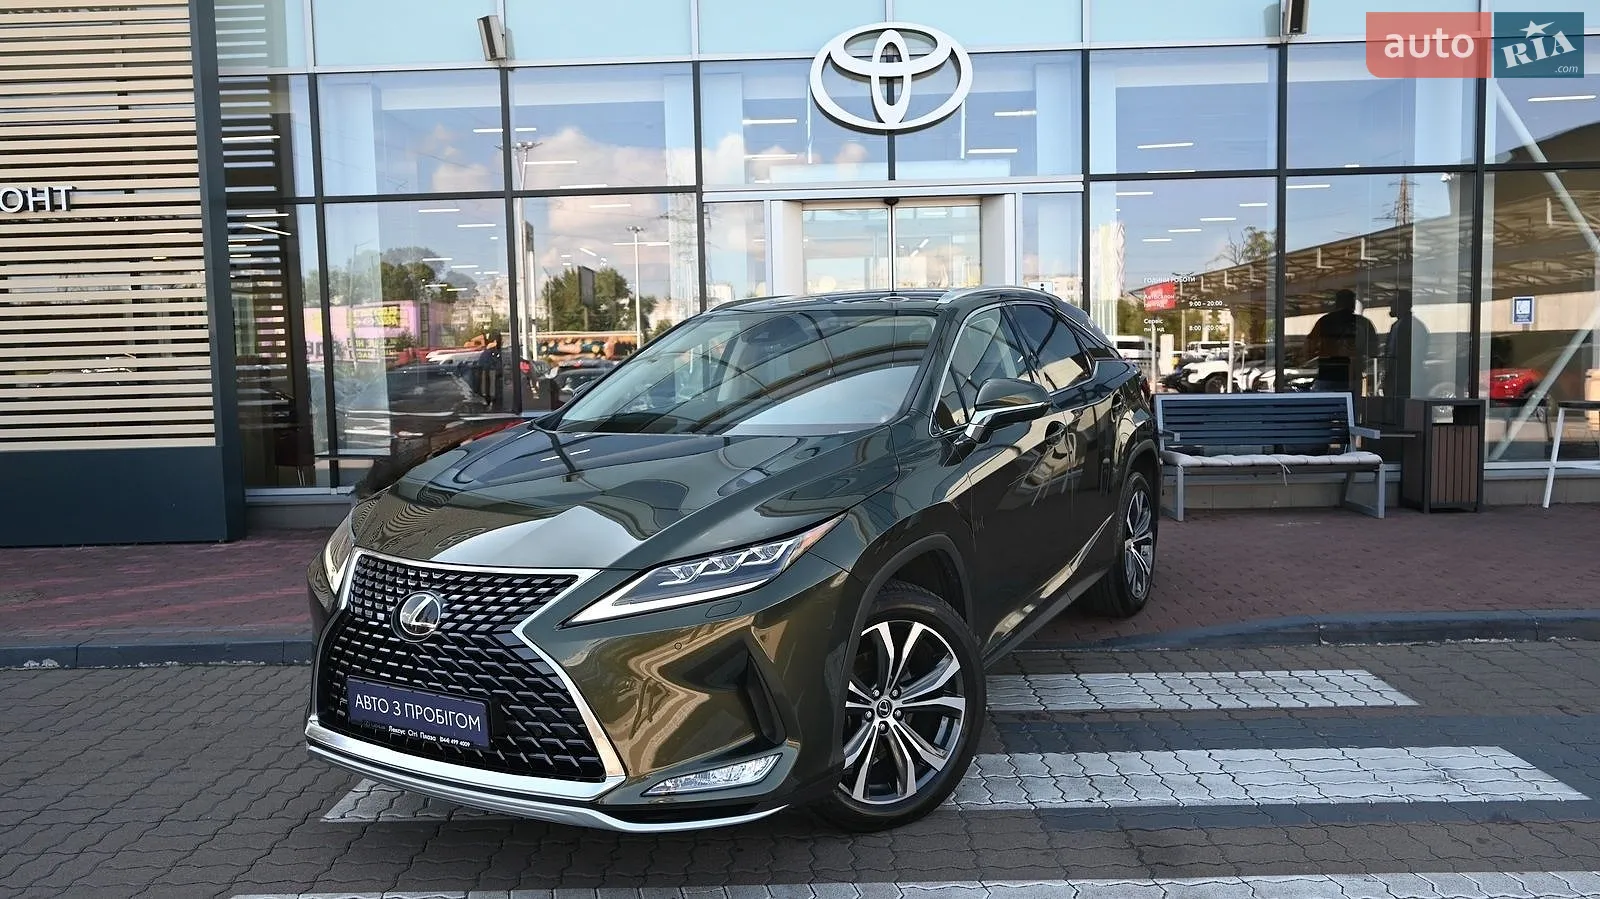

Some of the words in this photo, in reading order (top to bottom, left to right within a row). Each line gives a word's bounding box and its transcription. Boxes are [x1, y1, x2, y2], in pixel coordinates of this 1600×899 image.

[355, 693, 389, 714] АВТО
[404, 703, 481, 732] ПРОБІГОМ
[388, 725, 406, 736] Лексус
[420, 732, 437, 742] Плаза
